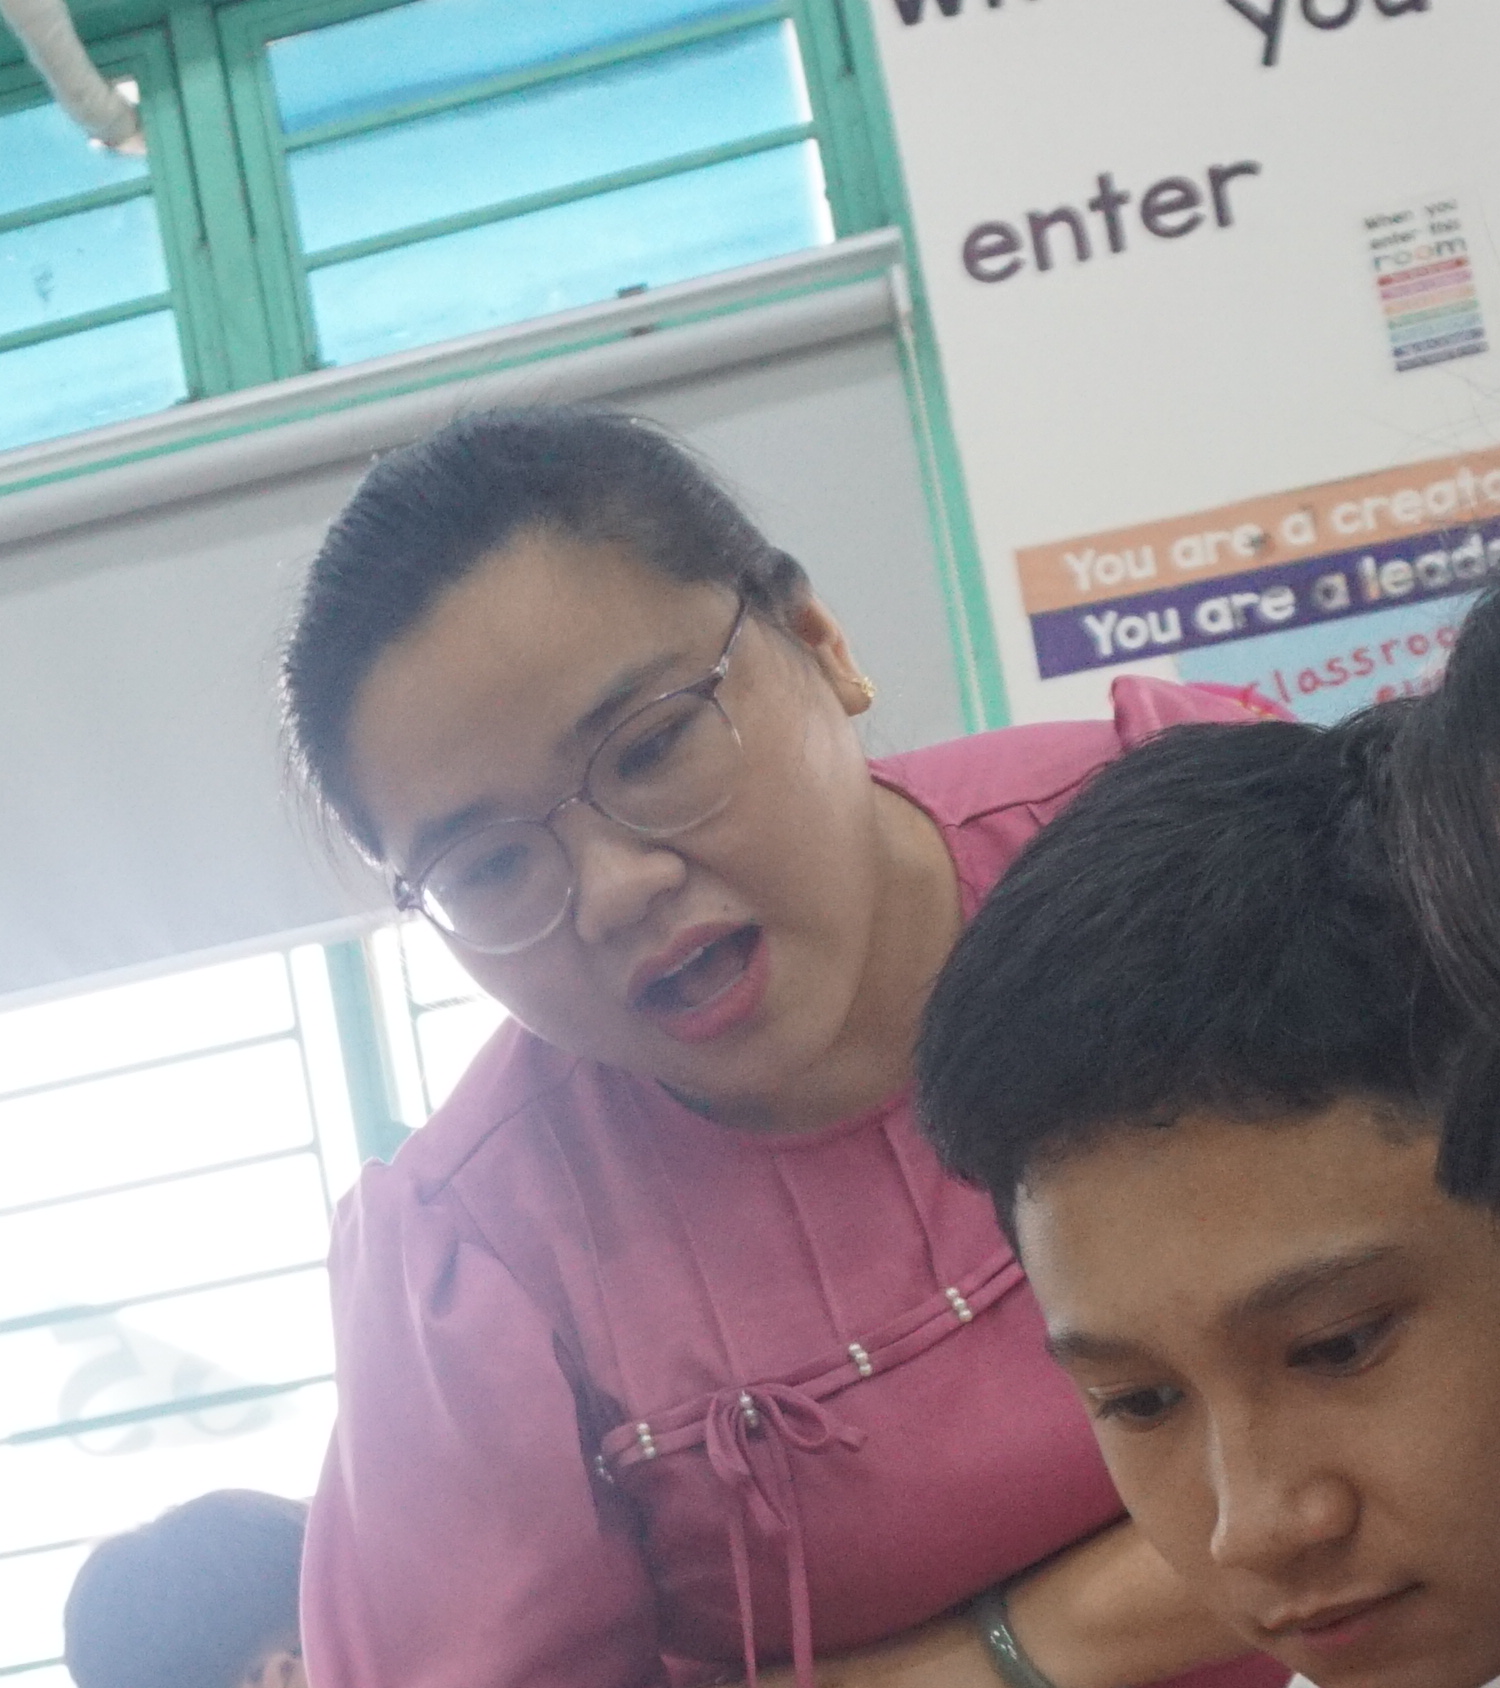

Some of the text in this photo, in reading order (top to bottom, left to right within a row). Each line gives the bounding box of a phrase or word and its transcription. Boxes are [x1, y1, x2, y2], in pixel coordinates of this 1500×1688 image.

[961, 159, 1263, 285] enter
[1063, 544, 1157, 592] You
[1170, 523, 1267, 570] are
[1279, 510, 1317, 546] a
[1082, 607, 1184, 657] You
[1193, 585, 1297, 634] are
[1312, 572, 1352, 611] a
